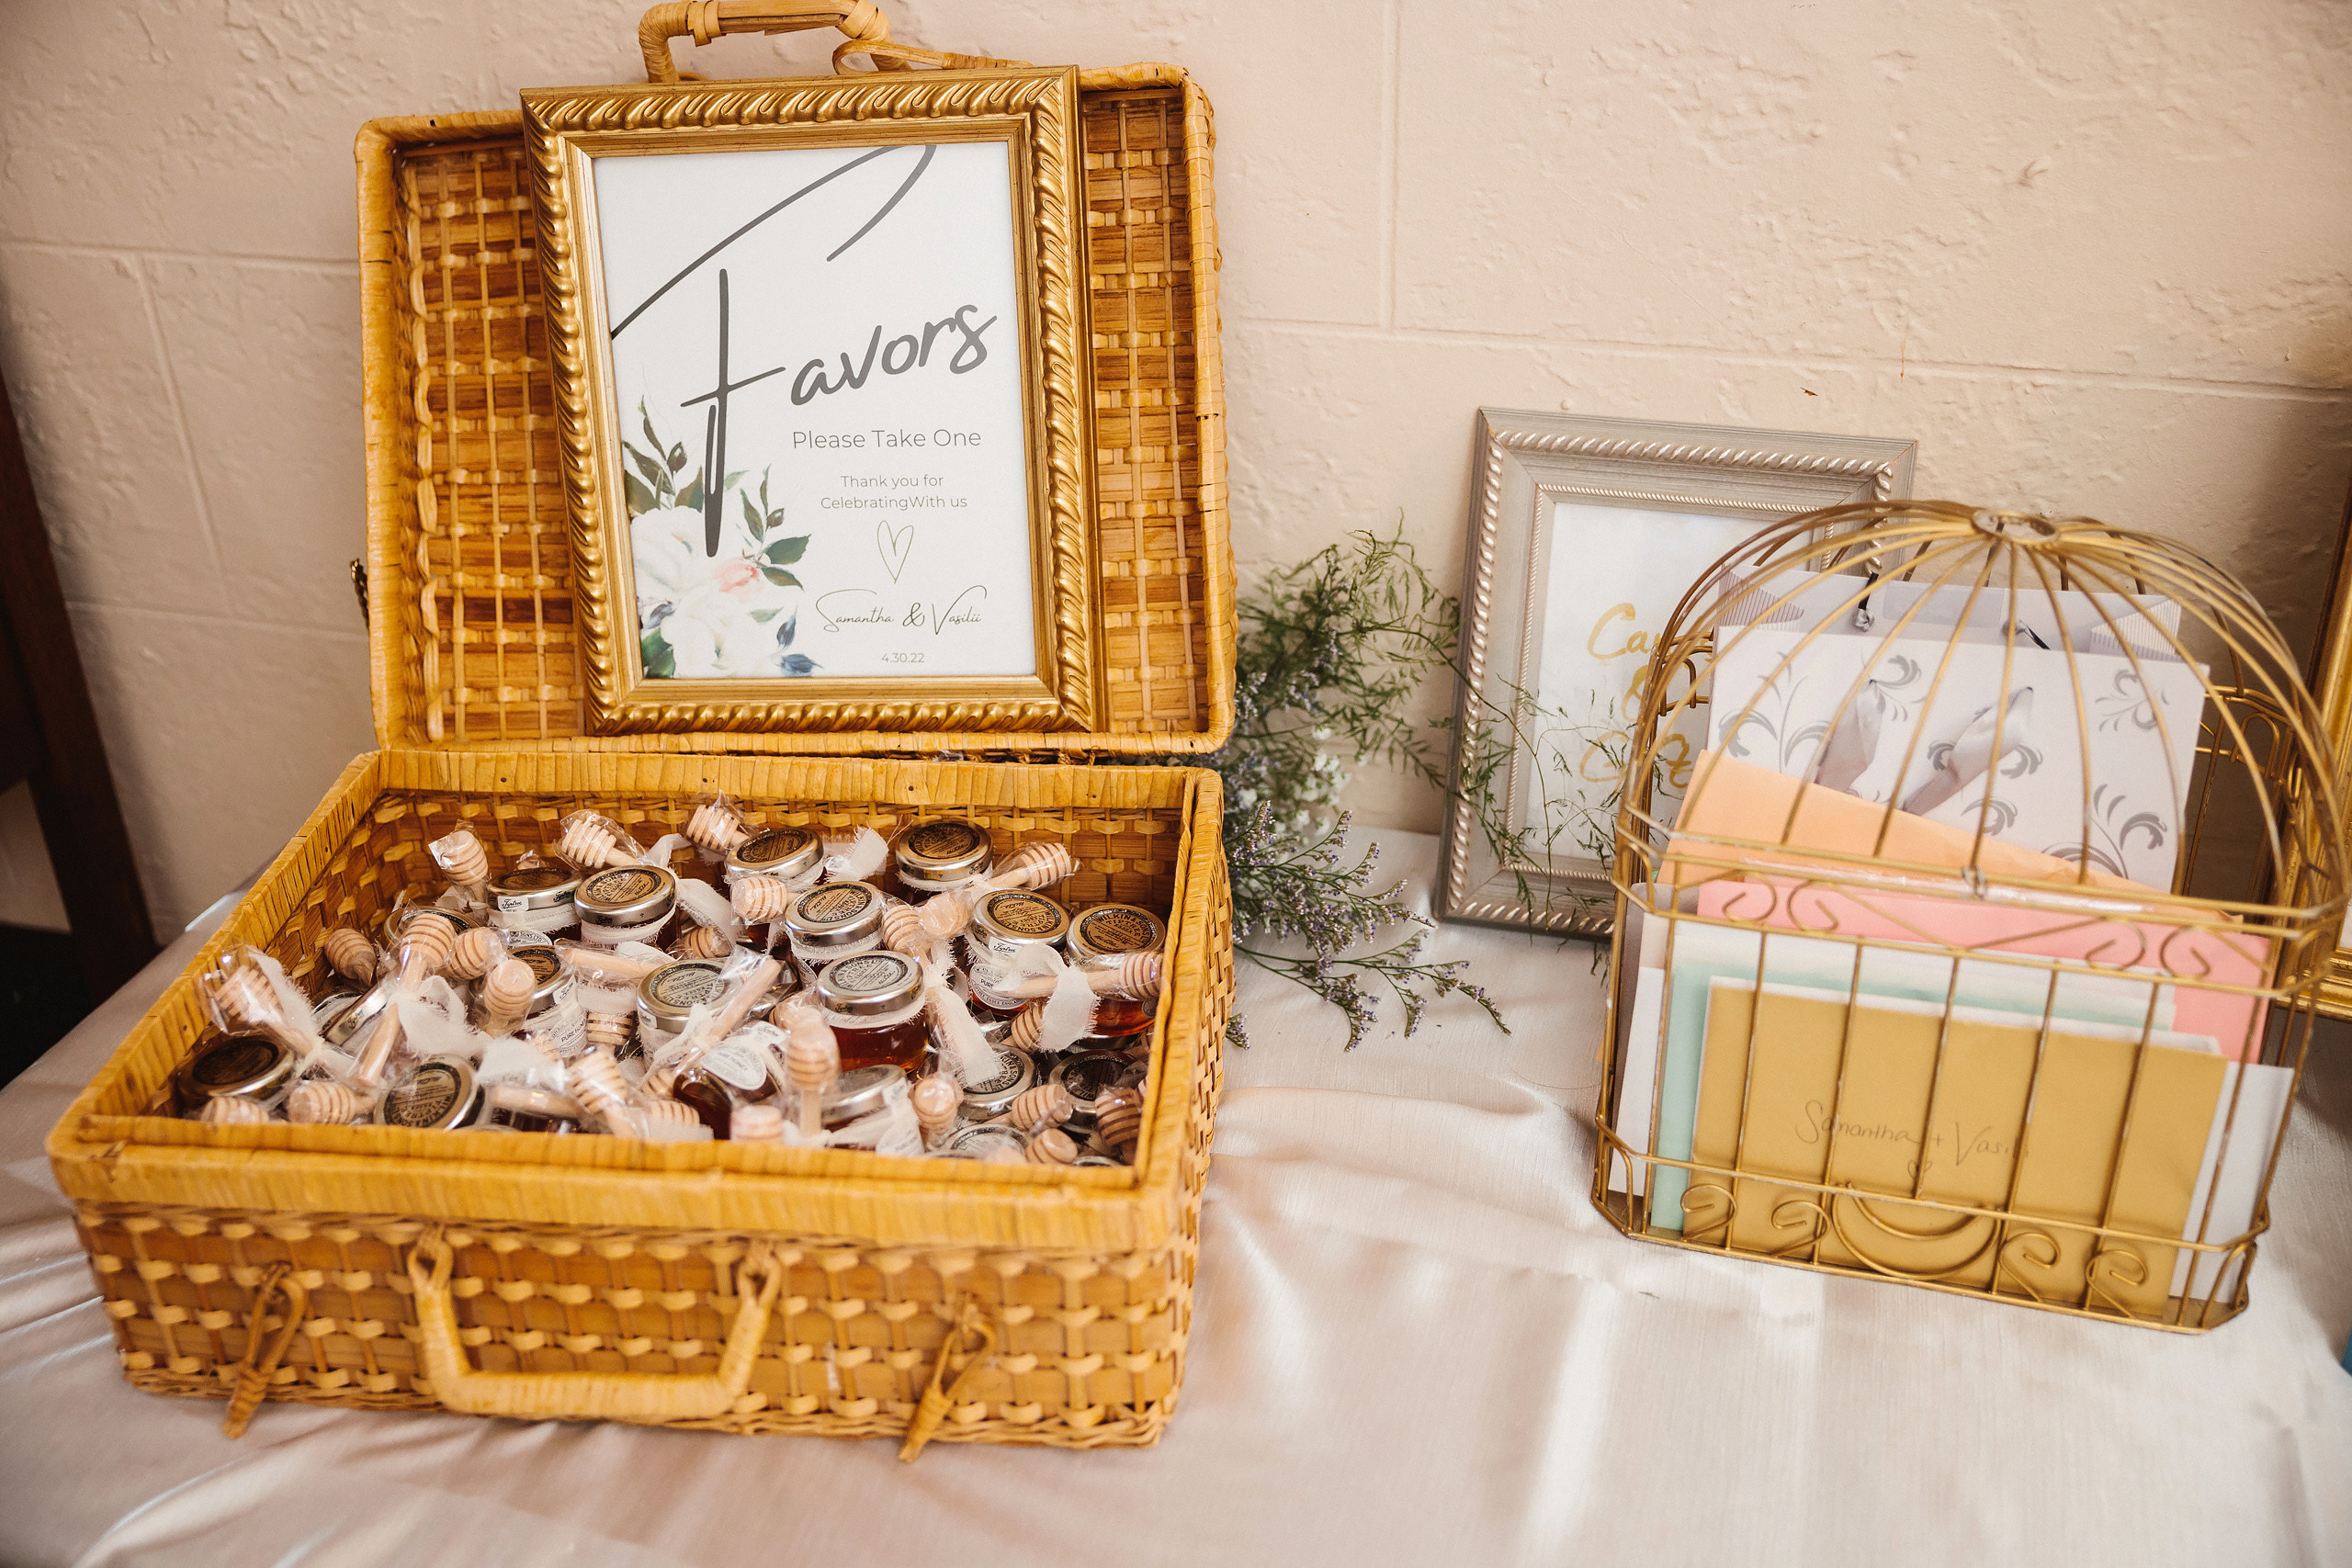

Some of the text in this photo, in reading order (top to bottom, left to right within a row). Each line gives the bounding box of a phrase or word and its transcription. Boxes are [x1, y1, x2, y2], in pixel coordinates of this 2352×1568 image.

[612, 145, 998, 557] Favors
[793, 429, 981, 448] Please Take One
[841, 474, 944, 490] Thank you for
[820, 496, 967, 511] CelebratingWith us
[816, 585, 987, 635] Samantha & Vasilii
[882, 652, 925, 663] 4.30.22
[849, 889, 865, 906] WILKIN
[834, 908, 857, 920] SONS
[1014, 924, 1036, 932] SONS
[1096, 913, 1131, 923] WILKIN
[1136, 919, 1150, 937] SONS
[1105, 919, 1141, 937] TIPTREE
[1114, 923, 1135, 934] ESSEX
[836, 973, 854, 987] WILKIN
[847, 960, 871, 969] SONS
[560, 1031, 575, 1043] PURE
[1002, 1070, 1017, 1085] SONS
[1795, 1100, 1920, 1145] Samantha
